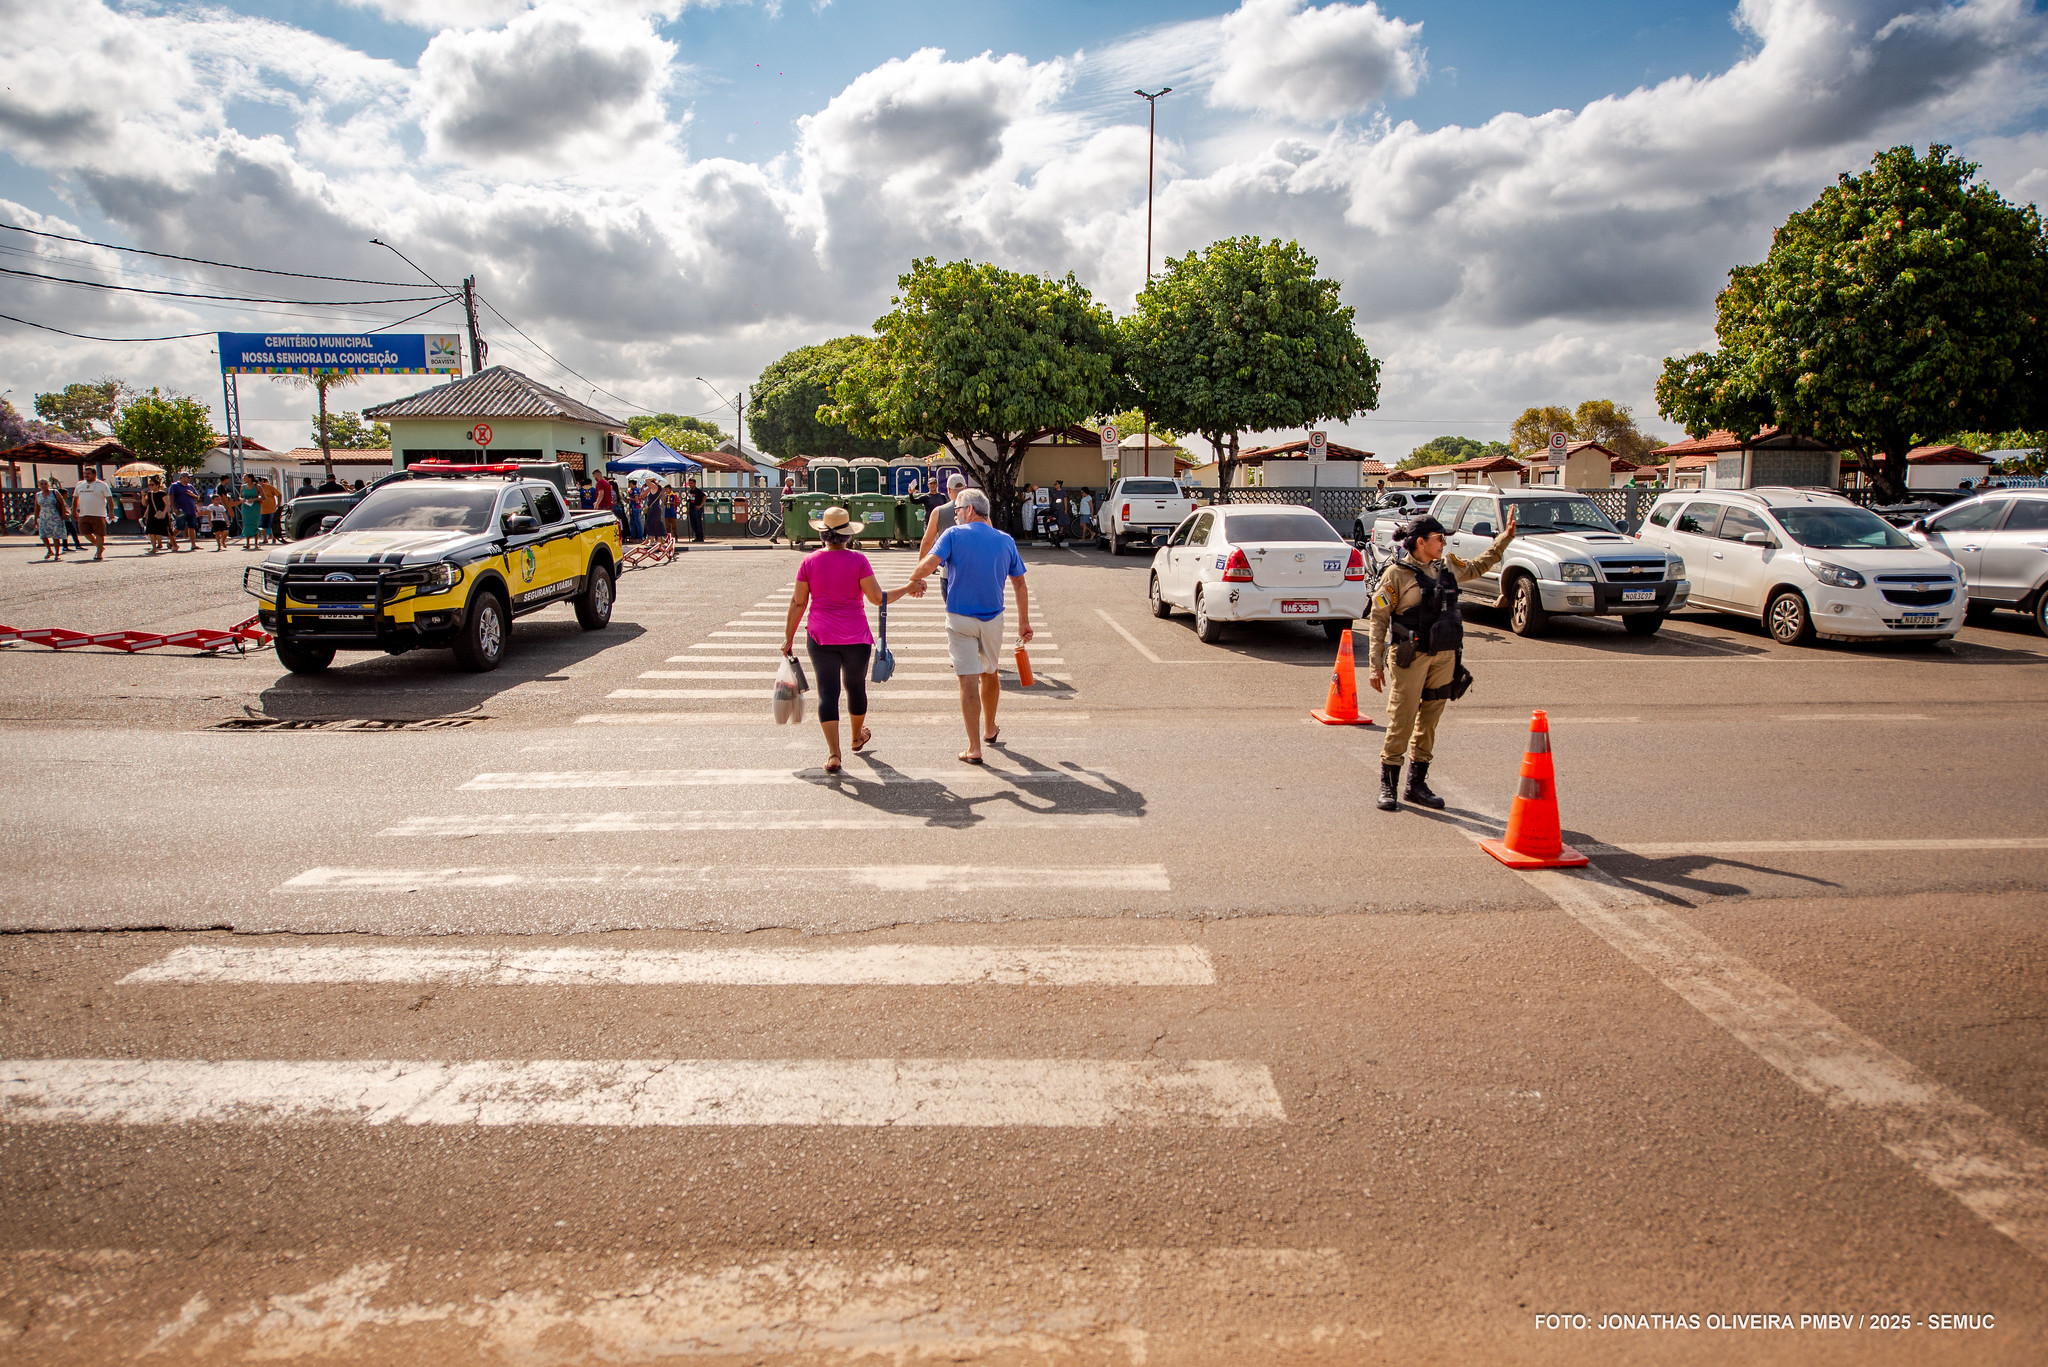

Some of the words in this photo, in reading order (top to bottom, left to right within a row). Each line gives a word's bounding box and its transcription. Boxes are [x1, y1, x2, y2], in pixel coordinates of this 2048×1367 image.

[265, 335, 318, 348] CEMITÉRIO
[319, 337, 373, 348] MUNICIPAL
[241, 352, 275, 364] NOSSA
[276, 352, 323, 364] SENHORA
[324, 352, 339, 364] DA
[339, 350, 398, 367] CONCEIÇÃO
[1106, 430, 1112, 439] E
[1315, 435, 1321, 445] E
[1555, 436, 1562, 445] E
[523, 584, 556, 602] SEGURANÇA
[556, 578, 573, 591] VIÁRIA
